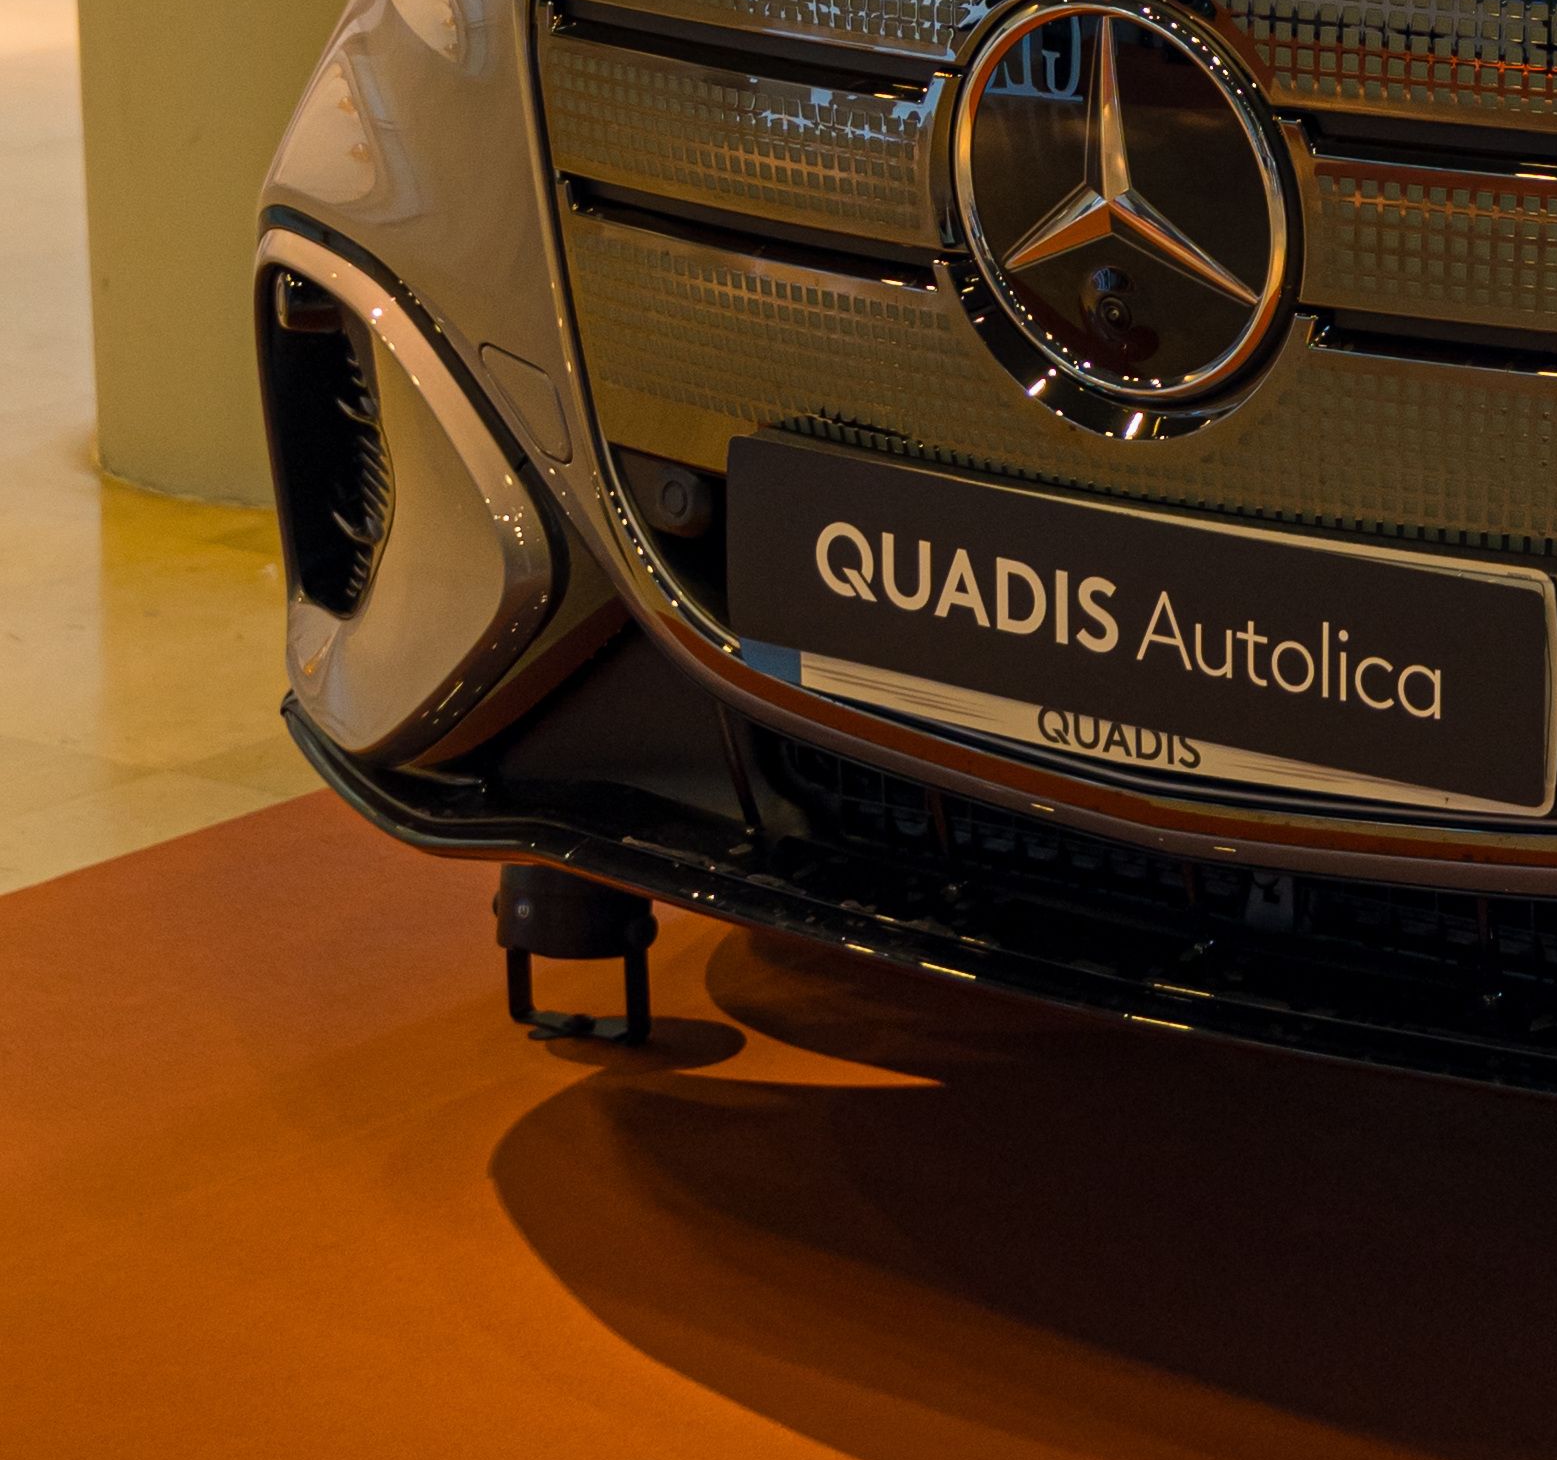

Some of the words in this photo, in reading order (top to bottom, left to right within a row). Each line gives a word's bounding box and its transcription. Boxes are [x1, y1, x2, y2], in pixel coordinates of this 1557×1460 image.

[815, 521, 1119, 654] QUADIS
[1136, 590, 1442, 720] Autolica
[1037, 706, 1201, 769] QUADIS
